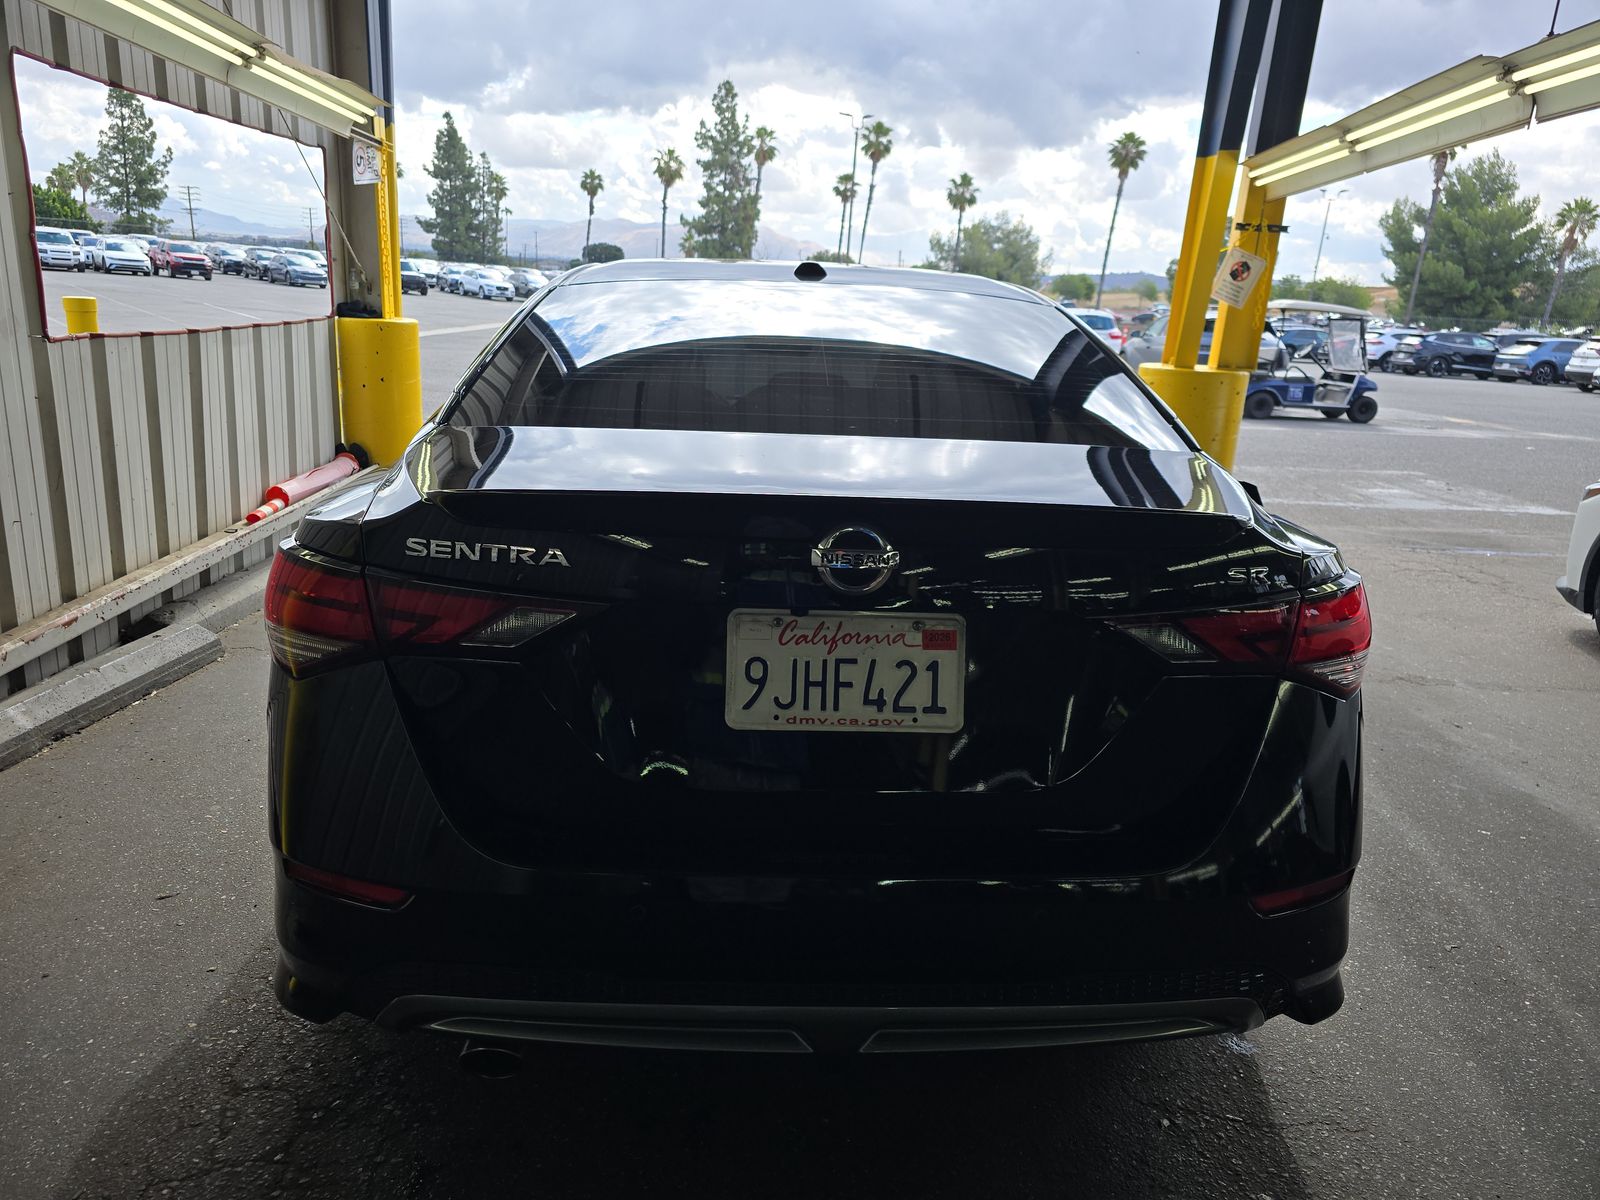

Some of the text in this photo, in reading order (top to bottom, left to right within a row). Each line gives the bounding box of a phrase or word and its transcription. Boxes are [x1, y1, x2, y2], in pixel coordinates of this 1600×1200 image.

[356, 154, 364, 168] 5
[405, 537, 571, 567] SENTRA
[821, 552, 890, 568] NISSAN
[1228, 566, 1271, 584] SR
[778, 619, 921, 655] California
[742, 656, 947, 715] 9JHF421
[786, 715, 905, 727] dmv.ca.gov
